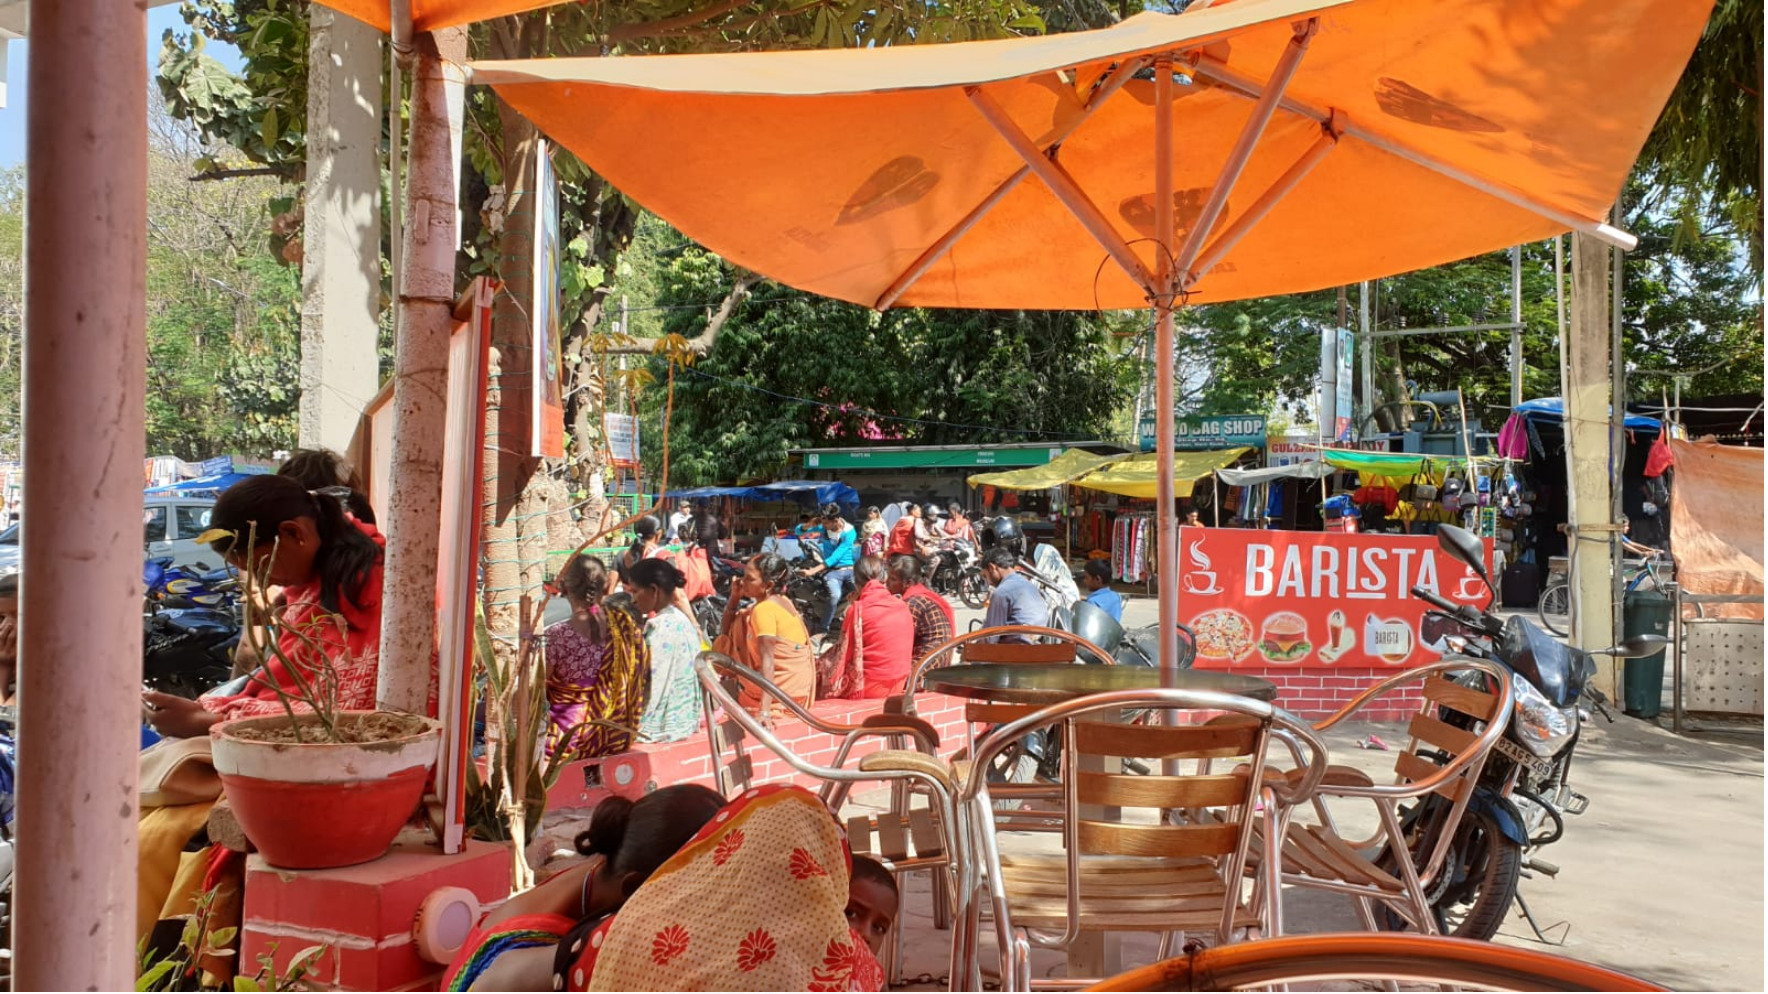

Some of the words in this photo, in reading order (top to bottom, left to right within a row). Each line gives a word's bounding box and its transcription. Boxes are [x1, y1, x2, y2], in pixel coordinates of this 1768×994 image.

[1224, 420, 1263, 435] SHOP
[1245, 543, 1440, 600] BARISTA
[1375, 630, 1399, 645] BARISTA
